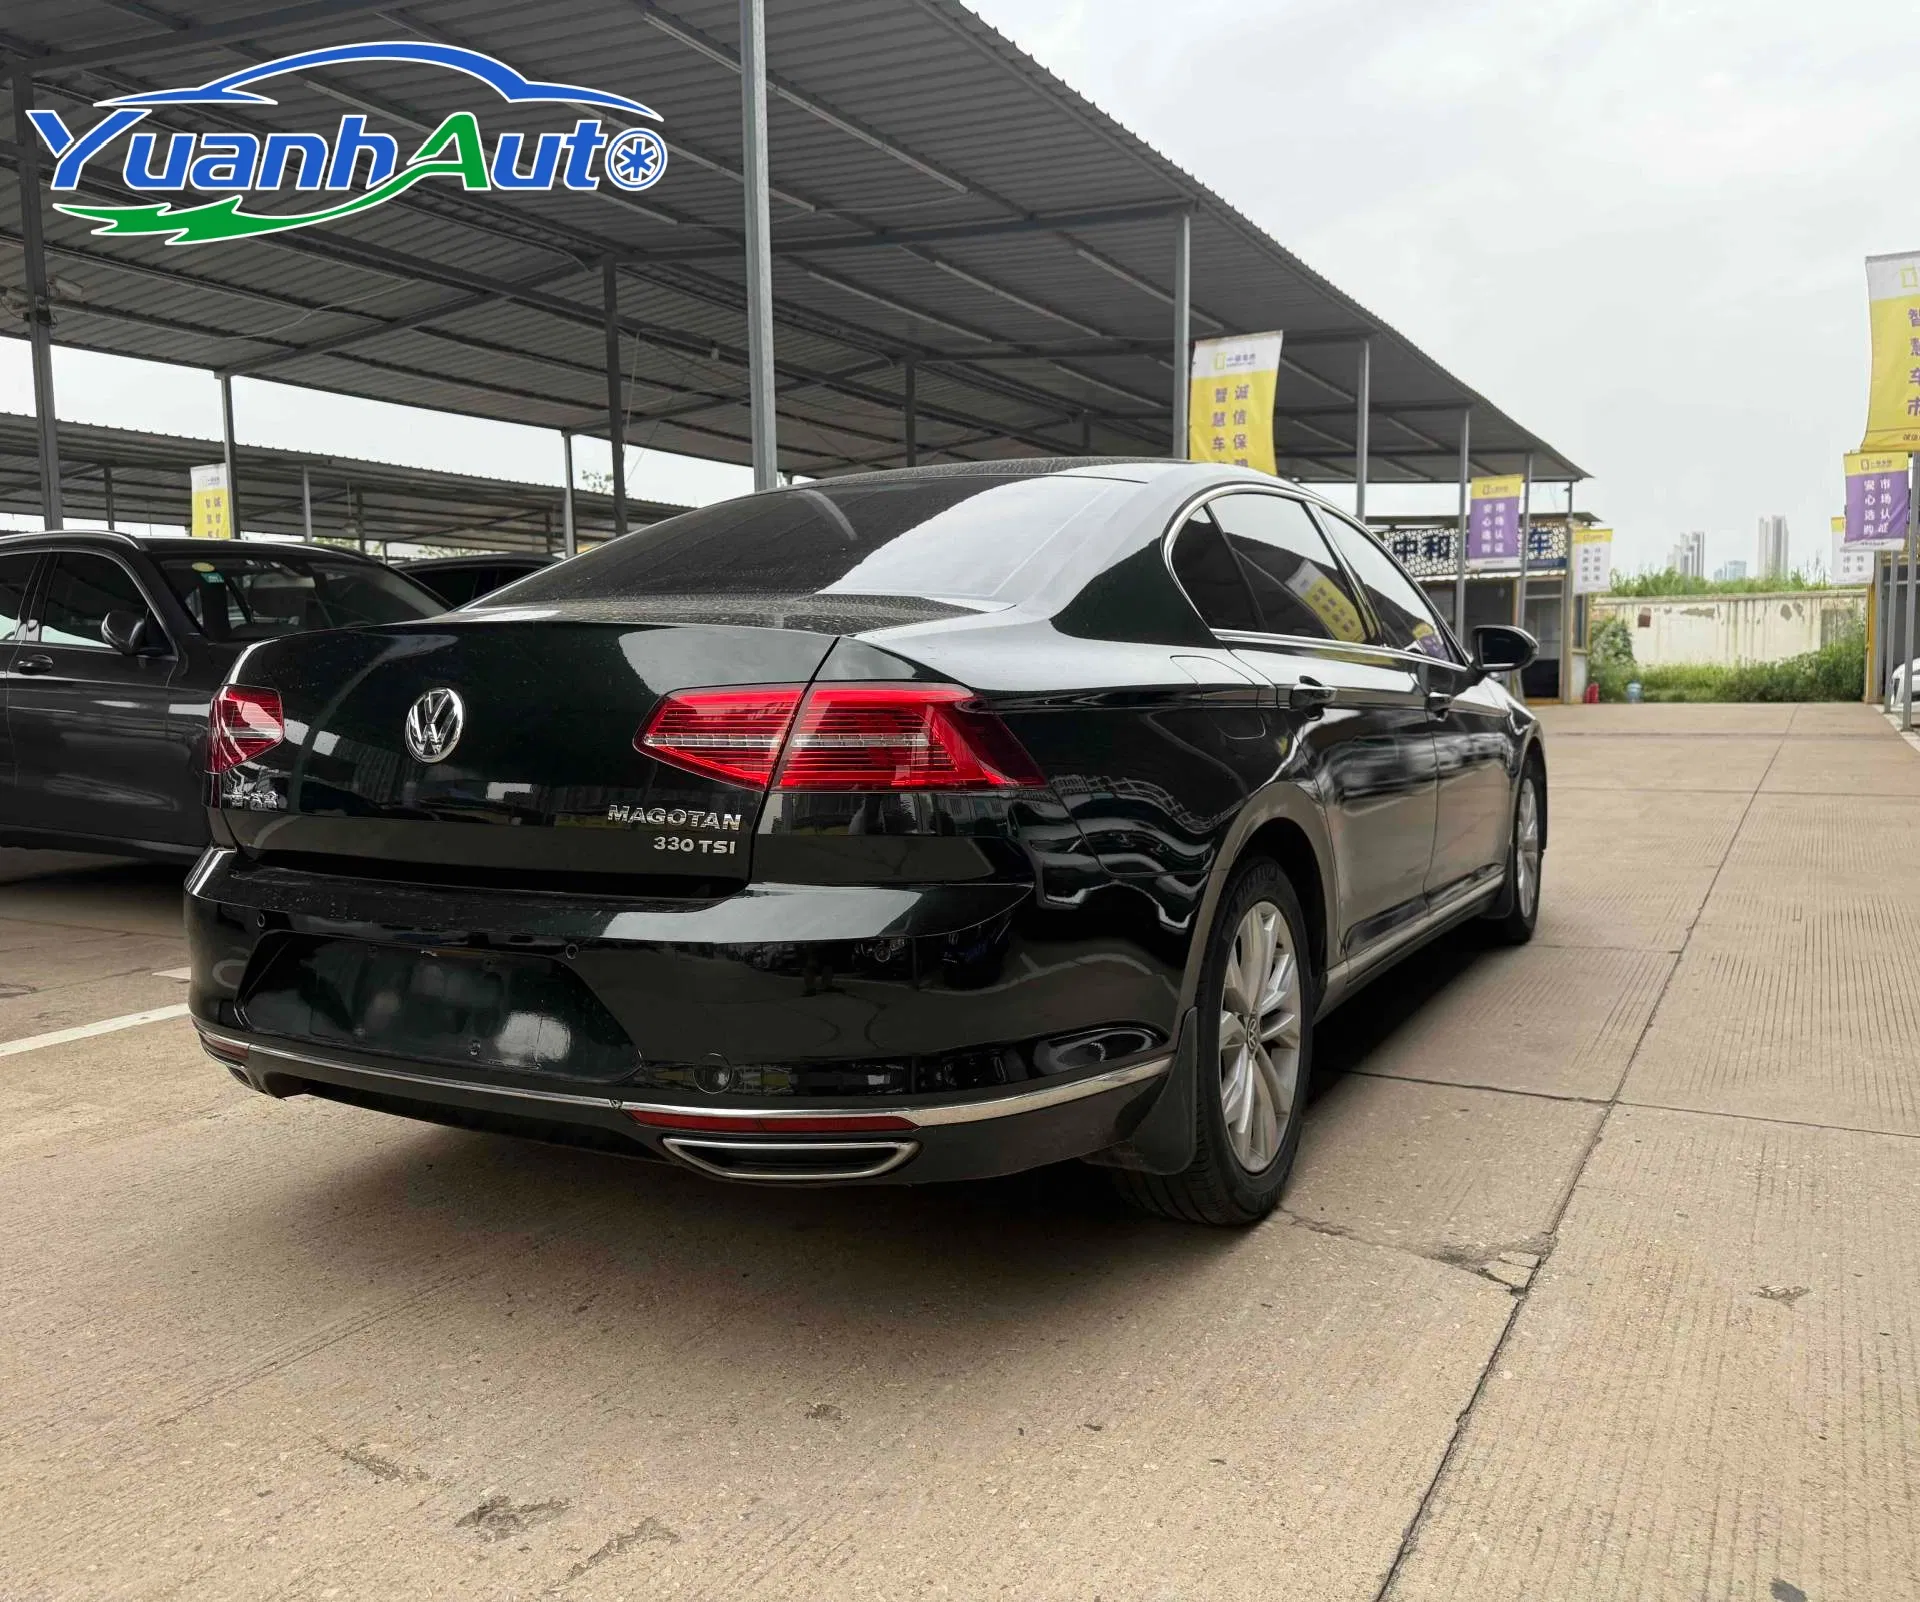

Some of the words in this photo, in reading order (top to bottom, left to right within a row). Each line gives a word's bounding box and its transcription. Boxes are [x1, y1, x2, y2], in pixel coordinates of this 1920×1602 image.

[1211, 387, 1228, 464] 智慧车
[607, 804, 741, 831] MAGOTAN
[653, 836, 694, 852] 330
[699, 840, 735, 854] TSI
